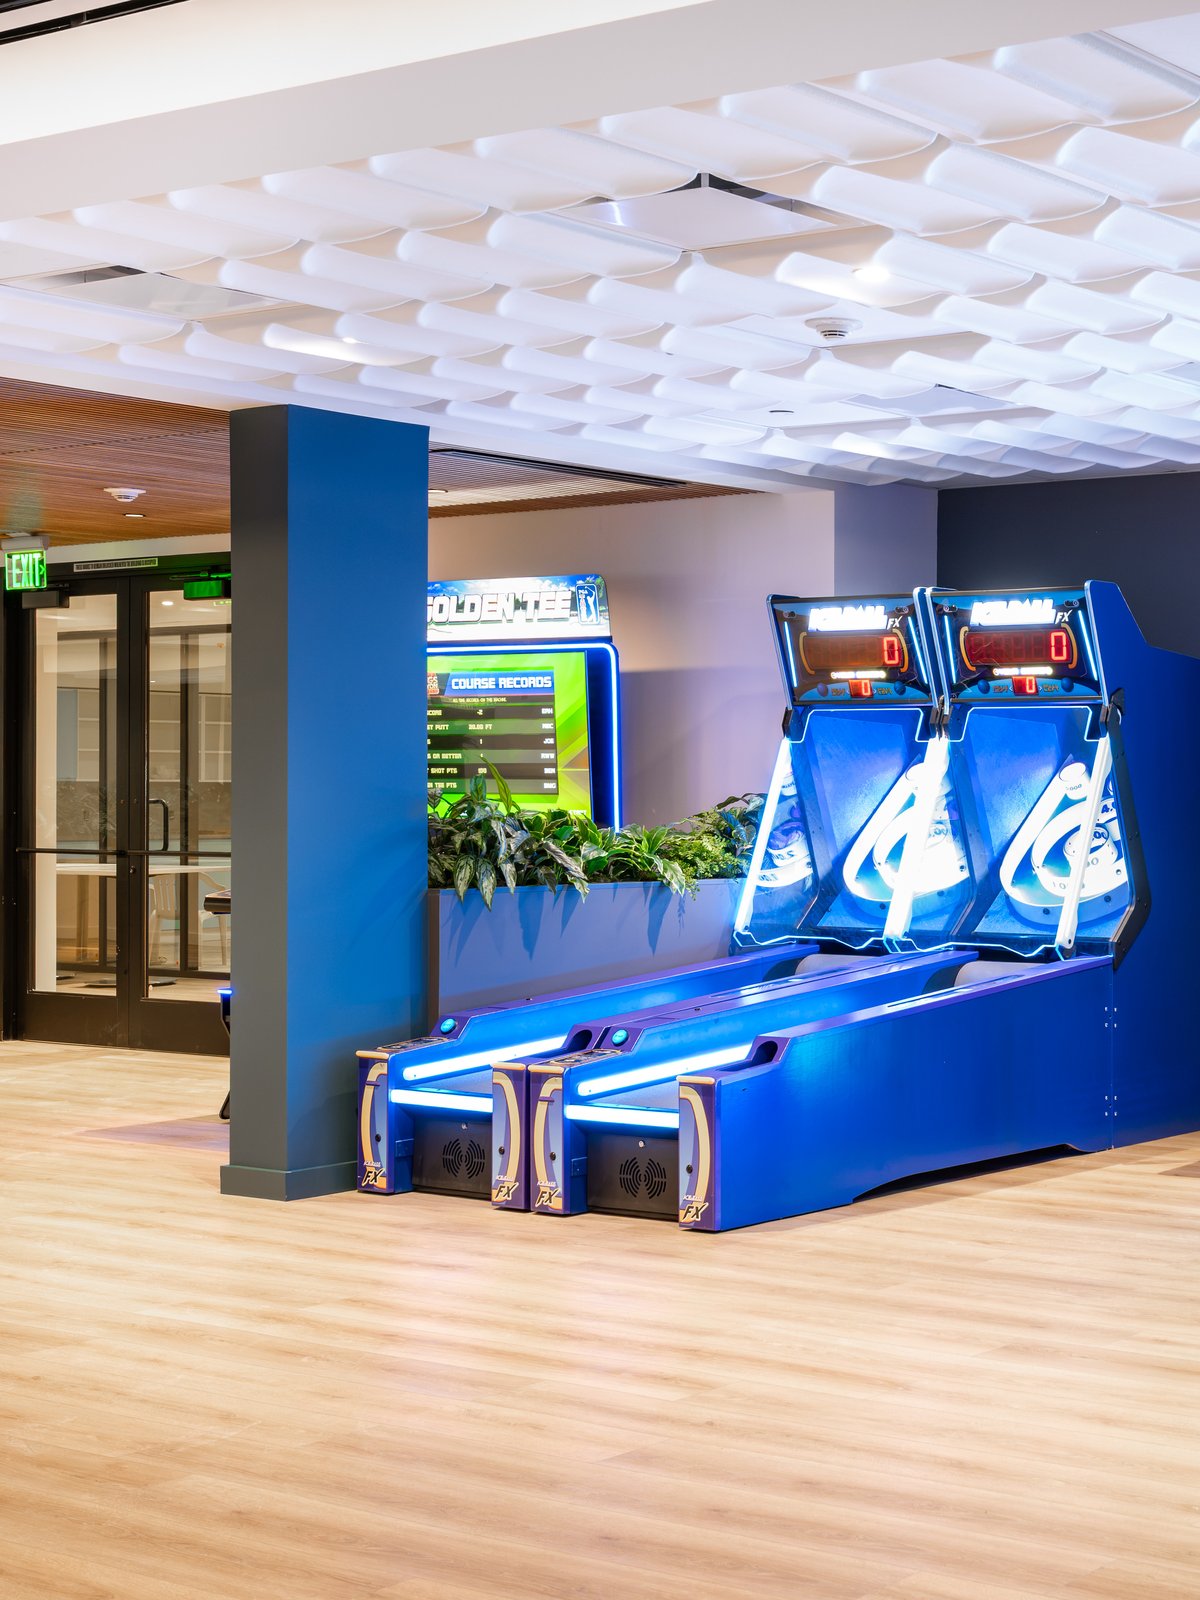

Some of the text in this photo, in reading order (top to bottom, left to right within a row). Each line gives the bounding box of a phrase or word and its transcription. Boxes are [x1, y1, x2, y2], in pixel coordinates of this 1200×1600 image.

[12, 553, 41, 588] EXIT
[522, 591, 571, 621] TEE
[887, 616, 902, 630] FX
[1055, 610, 1073, 624] FX
[883, 636, 899, 664] 0
[1050, 631, 1067, 660] 0
[451, 678, 496, 690] COURSE
[498, 676, 553, 688] RECORDS
[861, 679, 871, 695] 0
[1026, 676, 1036, 693] 0
[362, 1168, 384, 1186] FX
[495, 1181, 519, 1201] FX
[535, 1188, 560, 1207] FX
[682, 1202, 709, 1222] FX
